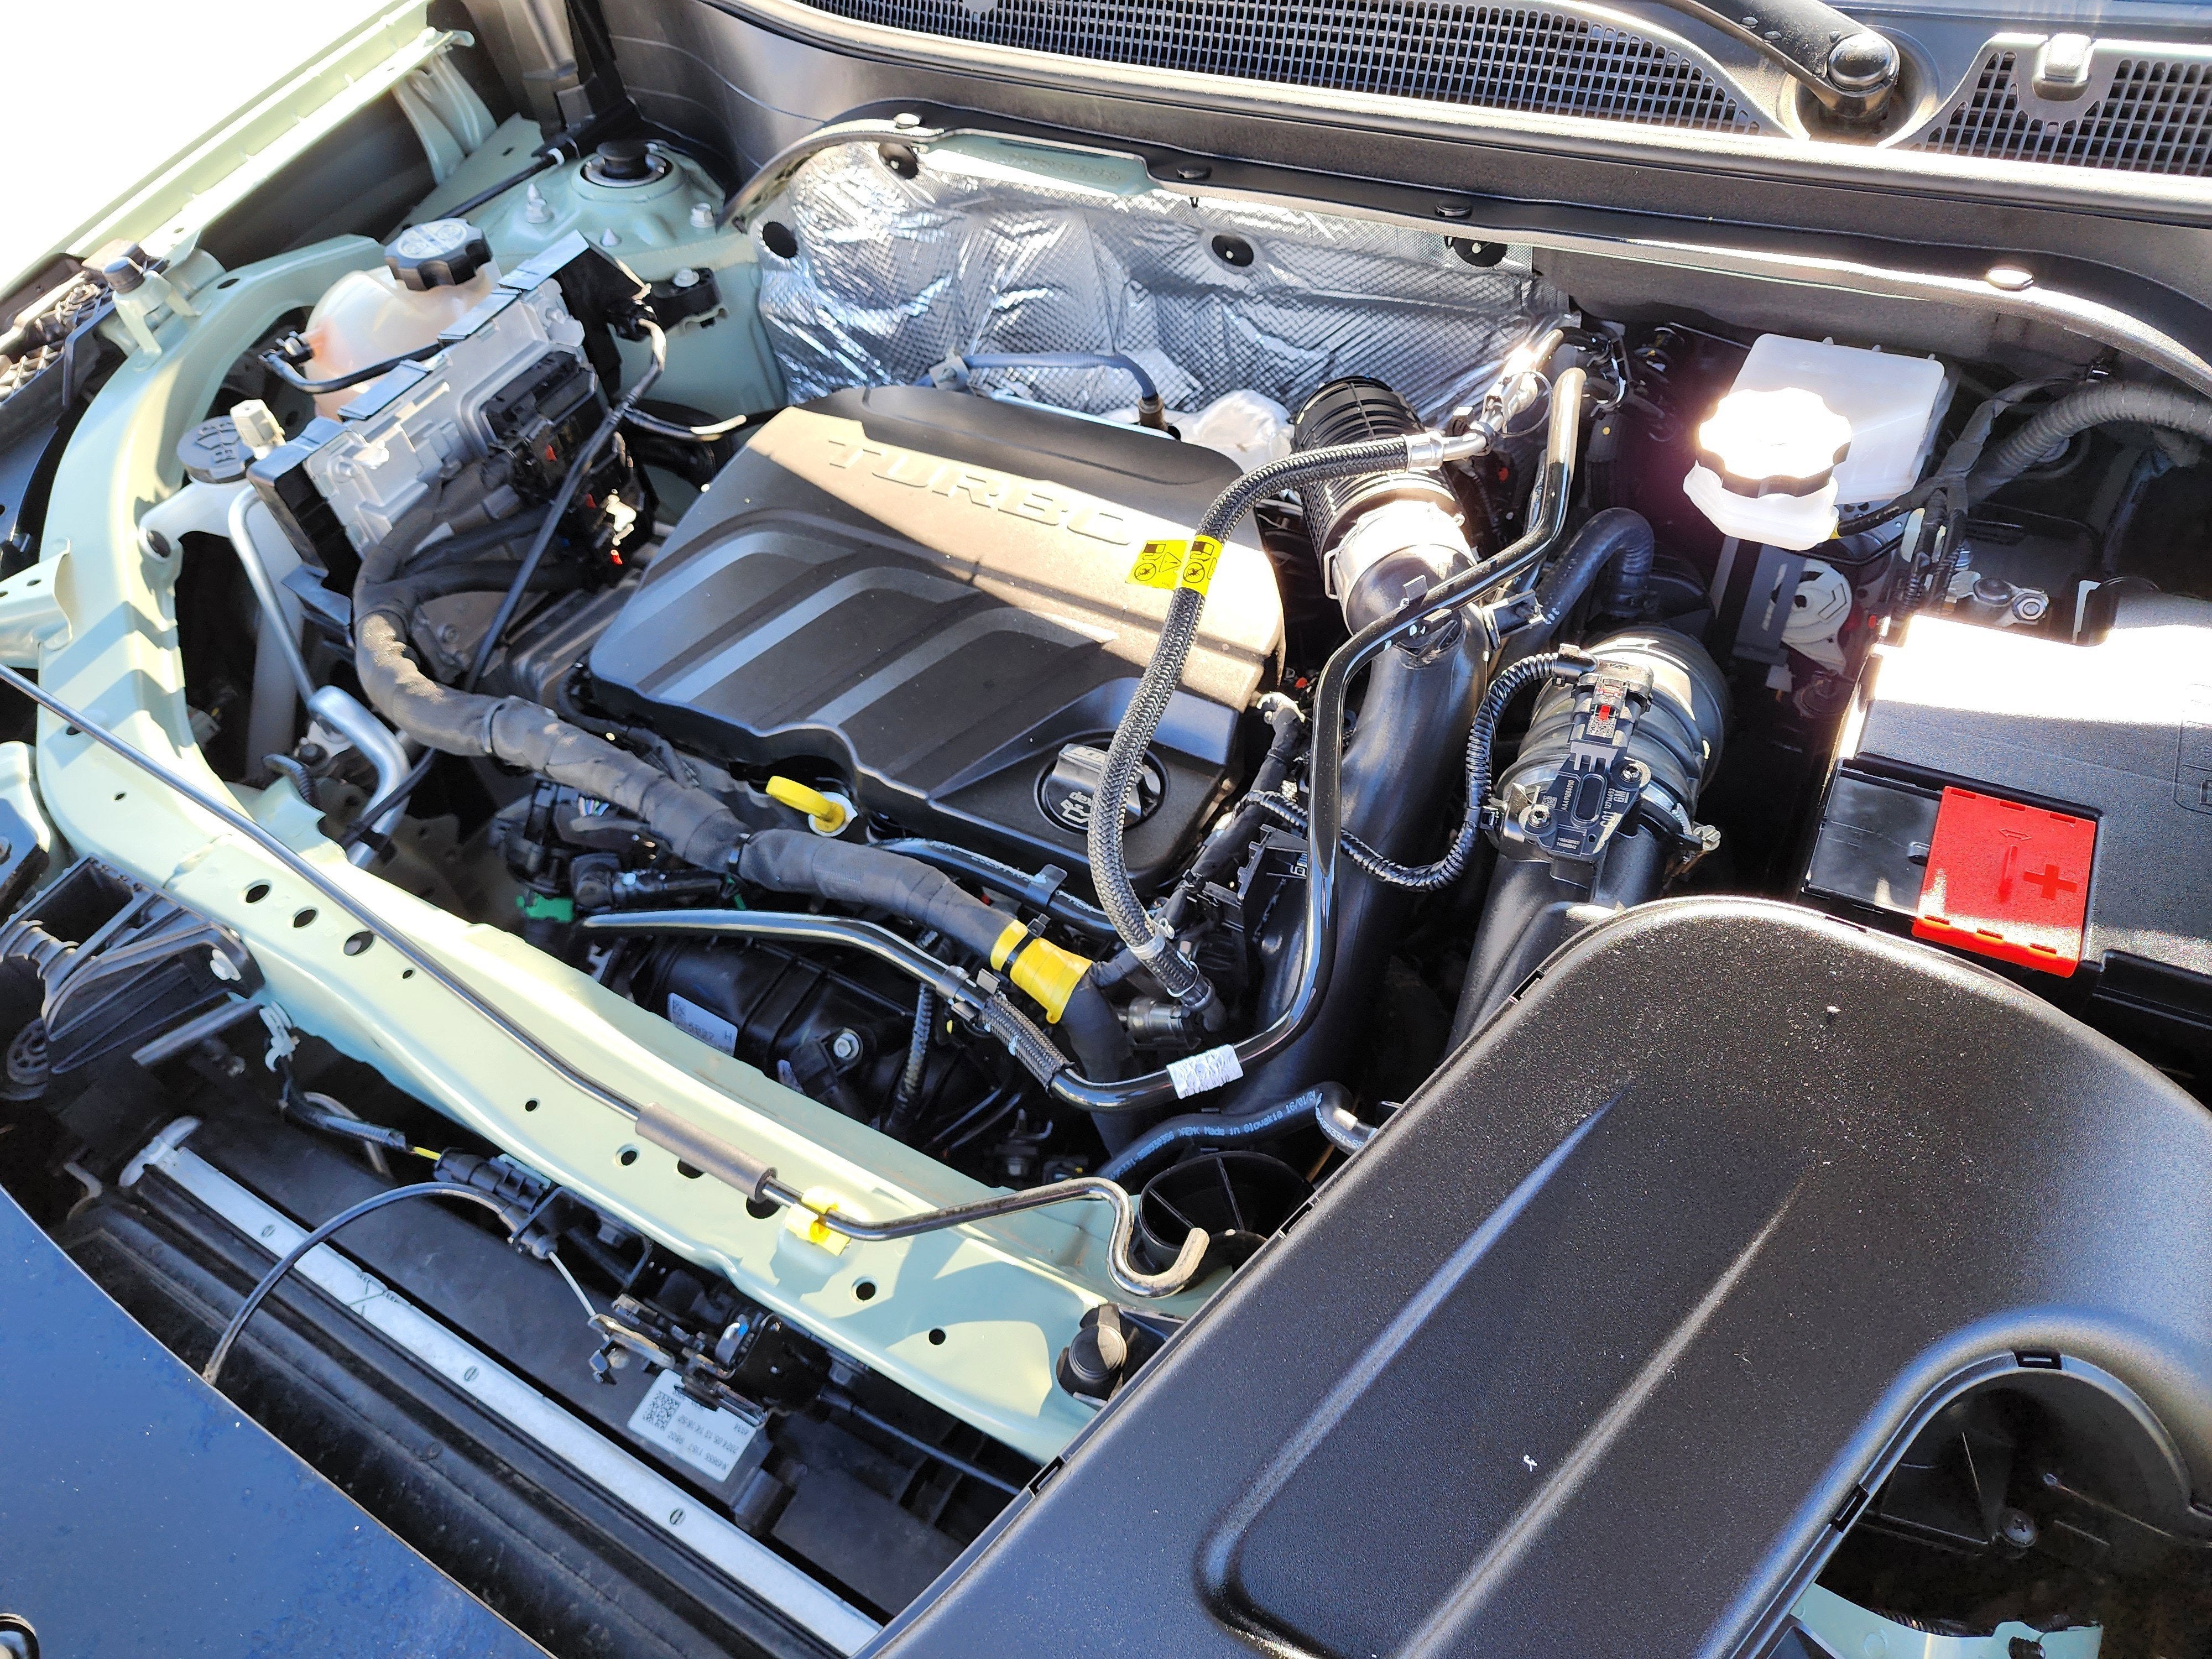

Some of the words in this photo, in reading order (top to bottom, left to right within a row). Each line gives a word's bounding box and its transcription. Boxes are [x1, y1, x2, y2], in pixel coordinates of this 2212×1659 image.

[828, 440, 1131, 546] TURBO
[1069, 791, 1093, 807] dex
[1614, 790, 1629, 804] GM
[1204, 1126, 1225, 1136] Made
[1229, 1127, 1240, 1136] in
[1243, 1109, 1284, 1134] Slovakia
